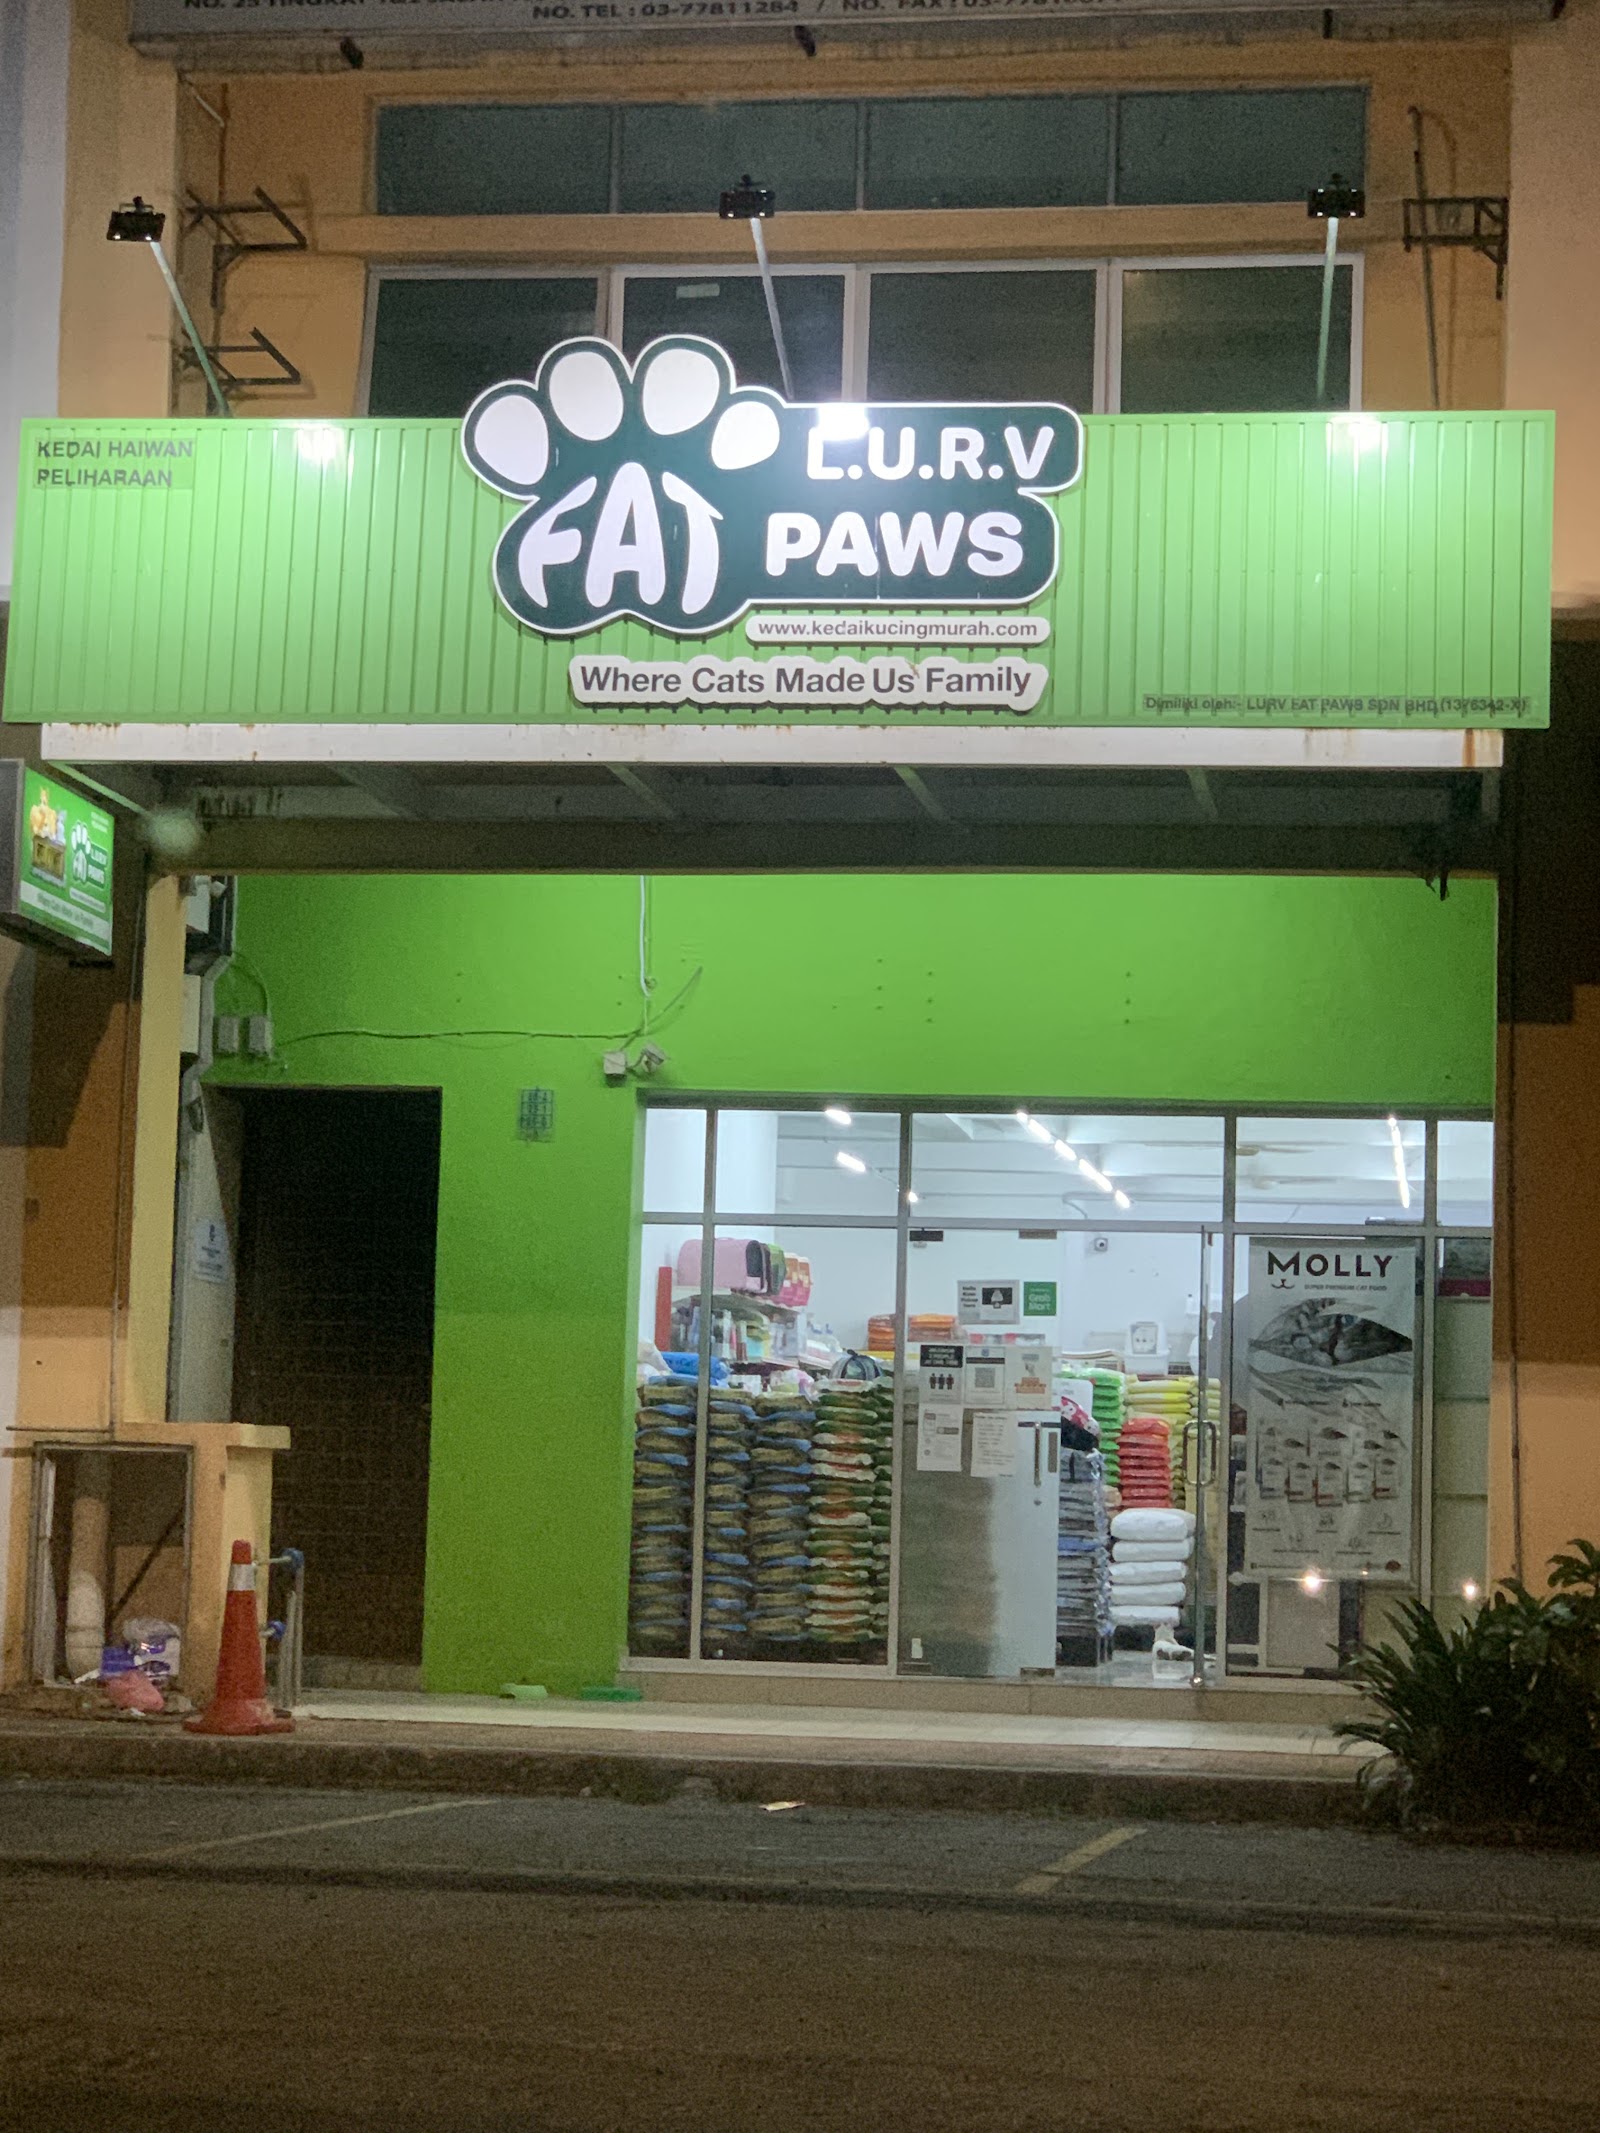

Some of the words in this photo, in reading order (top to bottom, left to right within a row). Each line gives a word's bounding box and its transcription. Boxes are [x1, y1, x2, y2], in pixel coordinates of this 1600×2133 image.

[533, 5, 575, 19] NO.
[581, 4, 621, 17] TEL
[843, 0, 885, 10] NO.
[37, 440, 100, 458] KEDAI
[107, 440, 192, 458] HAIWAN
[37, 468, 172, 486] PELIHARAAN
[518, 461, 724, 615] FAT
[766, 510, 1024, 577] PAWS
[758, 619, 1039, 641] www.kedaikucingmurah.com
[580, 665, 682, 694] Where
[692, 666, 764, 694] Cats
[776, 667, 864, 693] Made
[874, 667, 916, 693] Us
[926, 667, 1031, 698] Family
[1368, 698, 1399, 712] SDN
[1267, 1250, 1393, 1278] MOLLY
